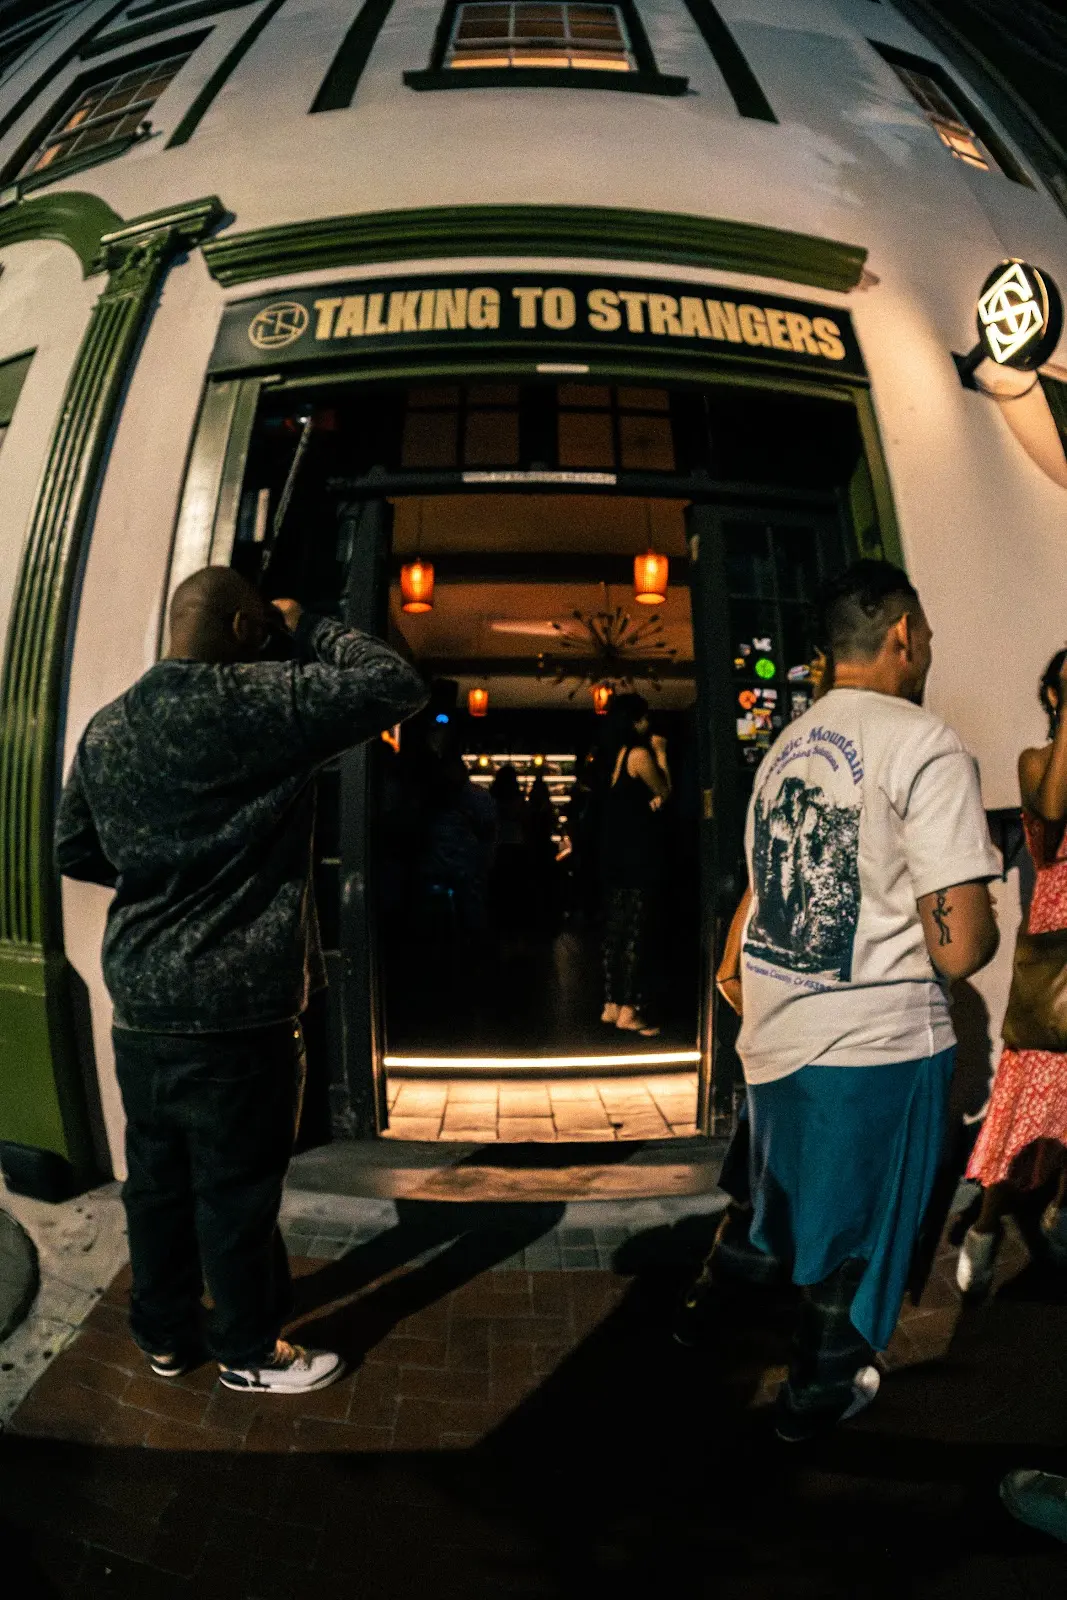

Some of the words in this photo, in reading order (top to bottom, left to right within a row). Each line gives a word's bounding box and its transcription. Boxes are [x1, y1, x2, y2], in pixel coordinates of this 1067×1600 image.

[314, 287, 501, 341] TALKING
[511, 287, 577, 331] TO
[586, 288, 847, 362] STRANGERS
[806, 725, 864, 785] Mountain
